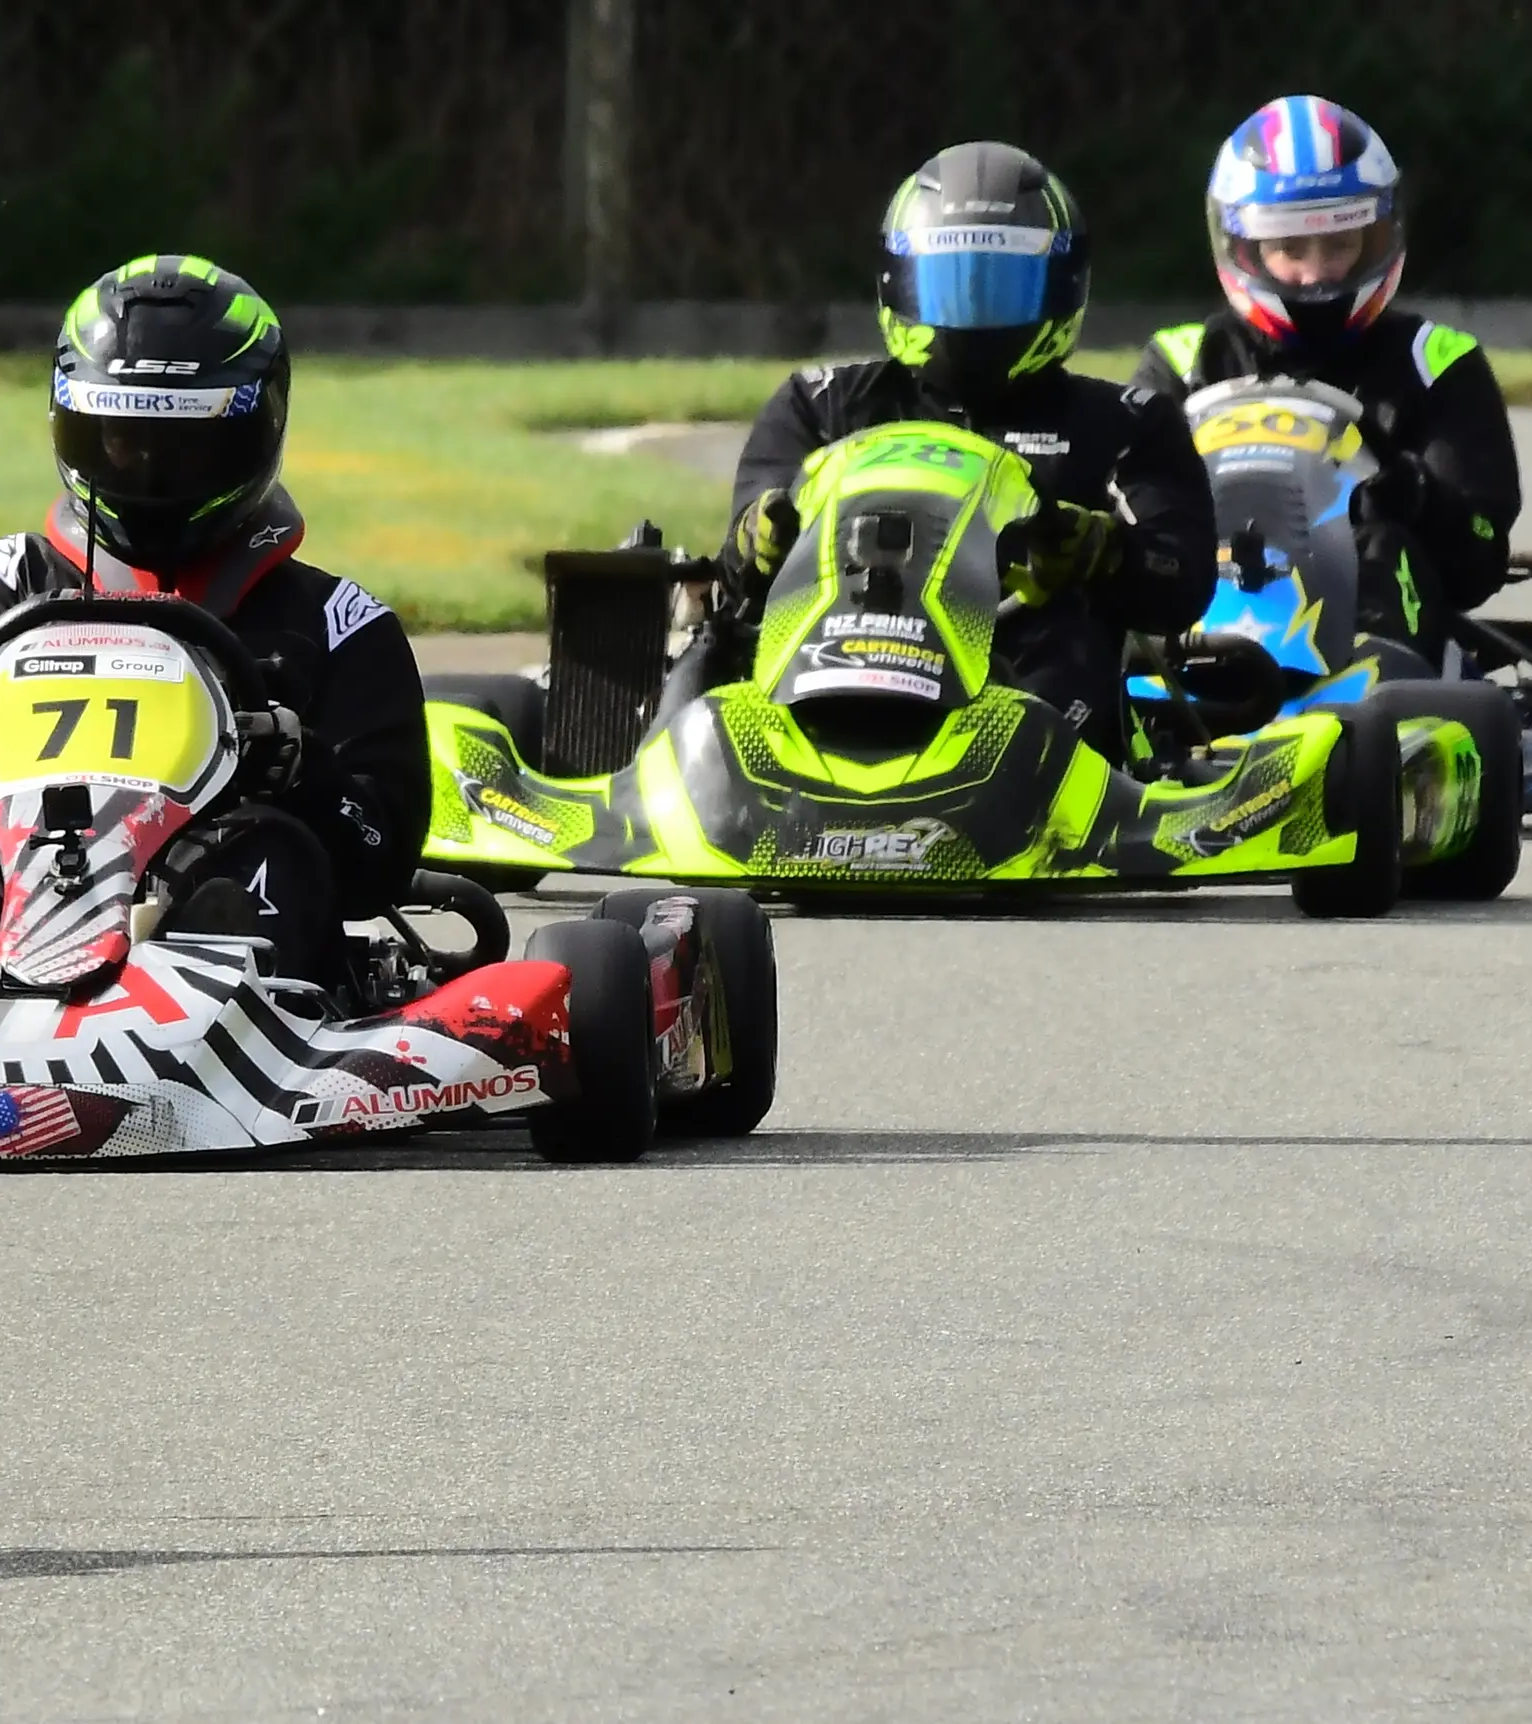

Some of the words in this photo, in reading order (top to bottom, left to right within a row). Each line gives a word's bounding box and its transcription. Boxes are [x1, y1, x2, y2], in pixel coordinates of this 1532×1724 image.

[107, 359, 200, 376] LS2
[86, 391, 174, 411] CARTER'S
[857, 443, 965, 470] 28
[825, 613, 857, 637] NZ
[861, 612, 927, 634] PRINT
[42, 637, 145, 649] ALUMINOS
[841, 640, 945, 665] CARTRIDGE
[23, 660, 85, 673] Giltrap
[111, 659, 165, 675] Group
[32, 698, 139, 761] 71
[343, 1069, 536, 1116] ALUMINOS
